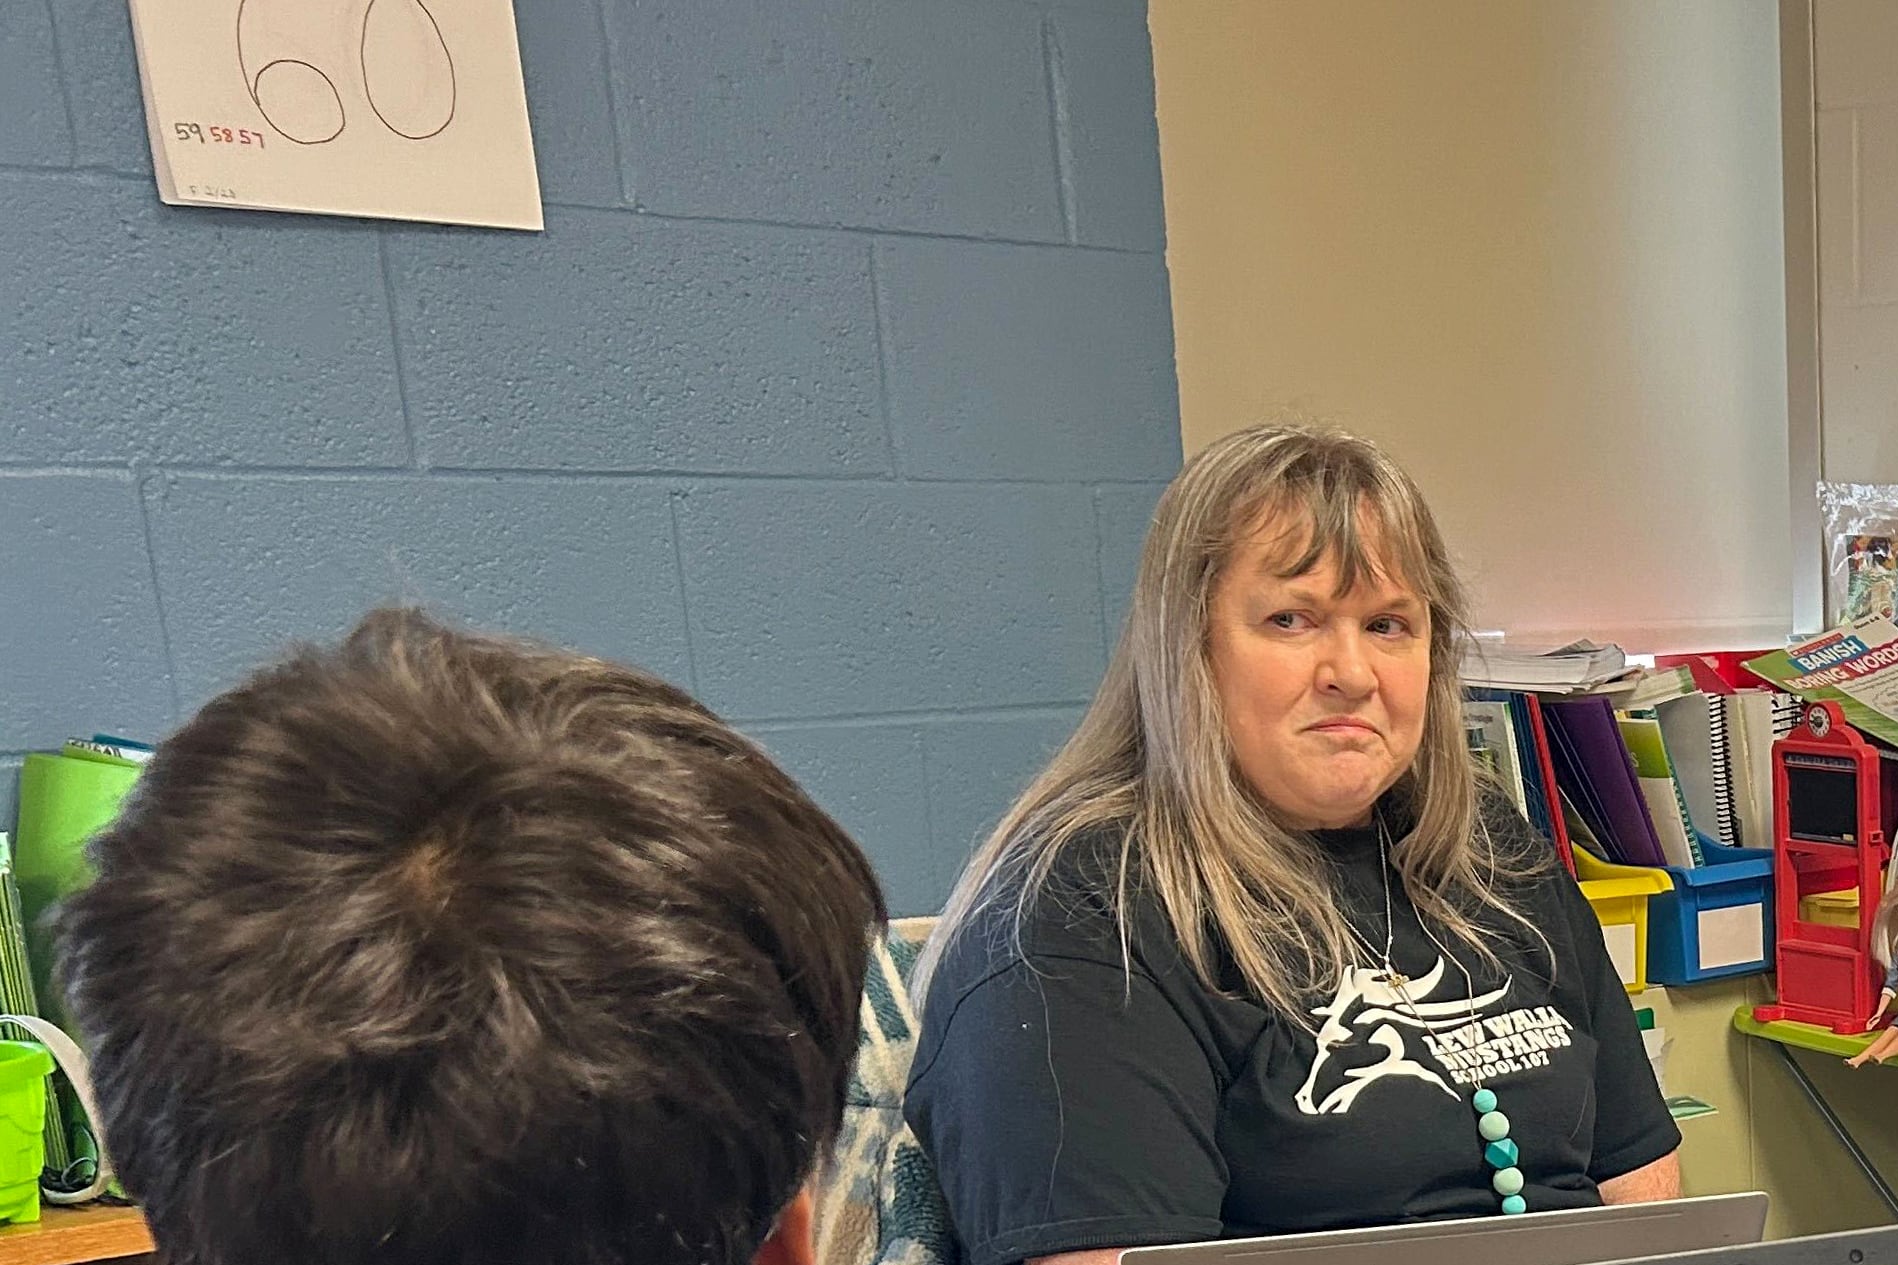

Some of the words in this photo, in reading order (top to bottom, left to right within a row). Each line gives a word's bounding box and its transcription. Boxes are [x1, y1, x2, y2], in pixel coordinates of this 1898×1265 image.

[237, 0, 456, 145] 60
[175, 123, 205, 144] 59
[210, 126, 233, 142] 58
[239, 130, 264, 148] 57
[1797, 639, 1862, 670] BANISH
[1435, 1026, 1571, 1070] MUSTANGS
[1450, 1059, 1522, 1084] SCHOOL
[1520, 1051, 1550, 1069] 107
